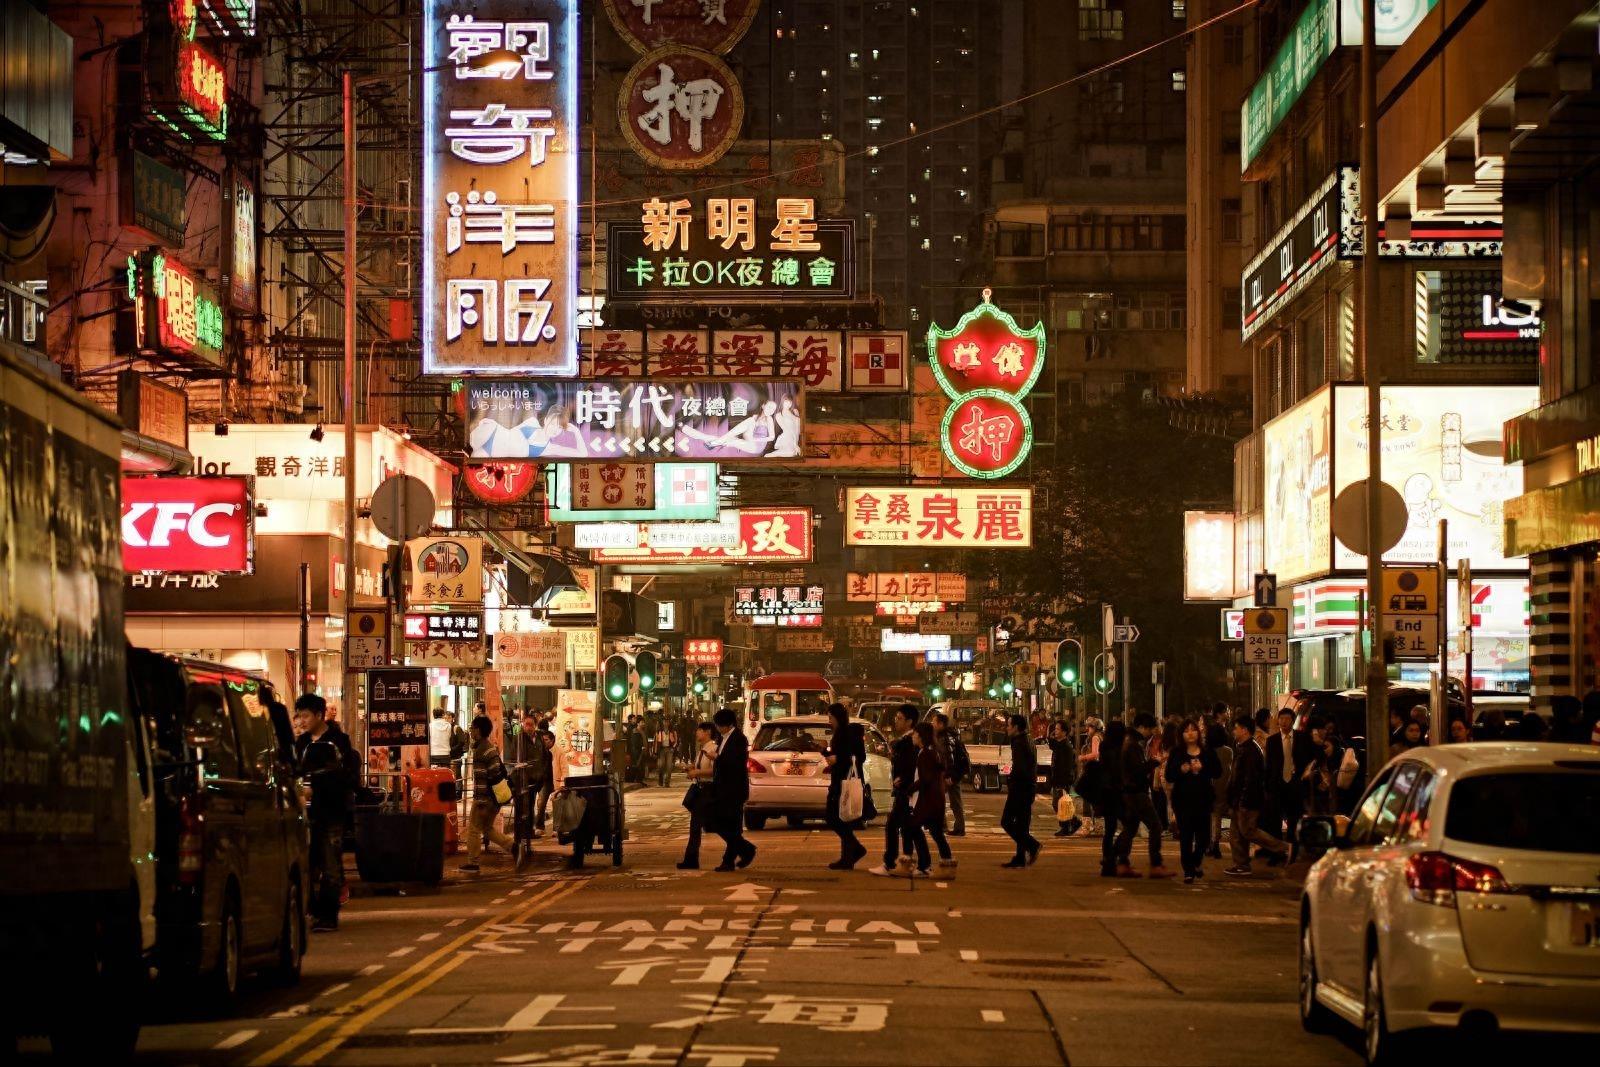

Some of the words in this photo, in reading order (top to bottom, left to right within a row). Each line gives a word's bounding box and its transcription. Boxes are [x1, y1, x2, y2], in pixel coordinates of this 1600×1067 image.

[638, 62, 724, 152] 押
[641, 198, 822, 251] 新明星
[627, 257, 836, 287] 卡拉OK夜總會
[471, 387, 530, 399] welcome
[471, 401, 543, 411] いらっしゃいませ
[576, 385, 675, 429] 時代
[681, 397, 750, 417] 夜總會
[959, 405, 1015, 462] 押
[121, 503, 235, 547] KFC
[736, 586, 823, 602] 百利酒店
[1394, 619, 1422, 631] End
[376, 639, 382, 649] 7
[1249, 636, 1263, 645] 24
[1266, 636, 1282, 645] hrs
[372, 655, 383, 666] 12
[1253, 647, 1278, 660] 全日
[474, 918, 941, 936] SHANGHAI
[458, 935, 940, 955] STREET
